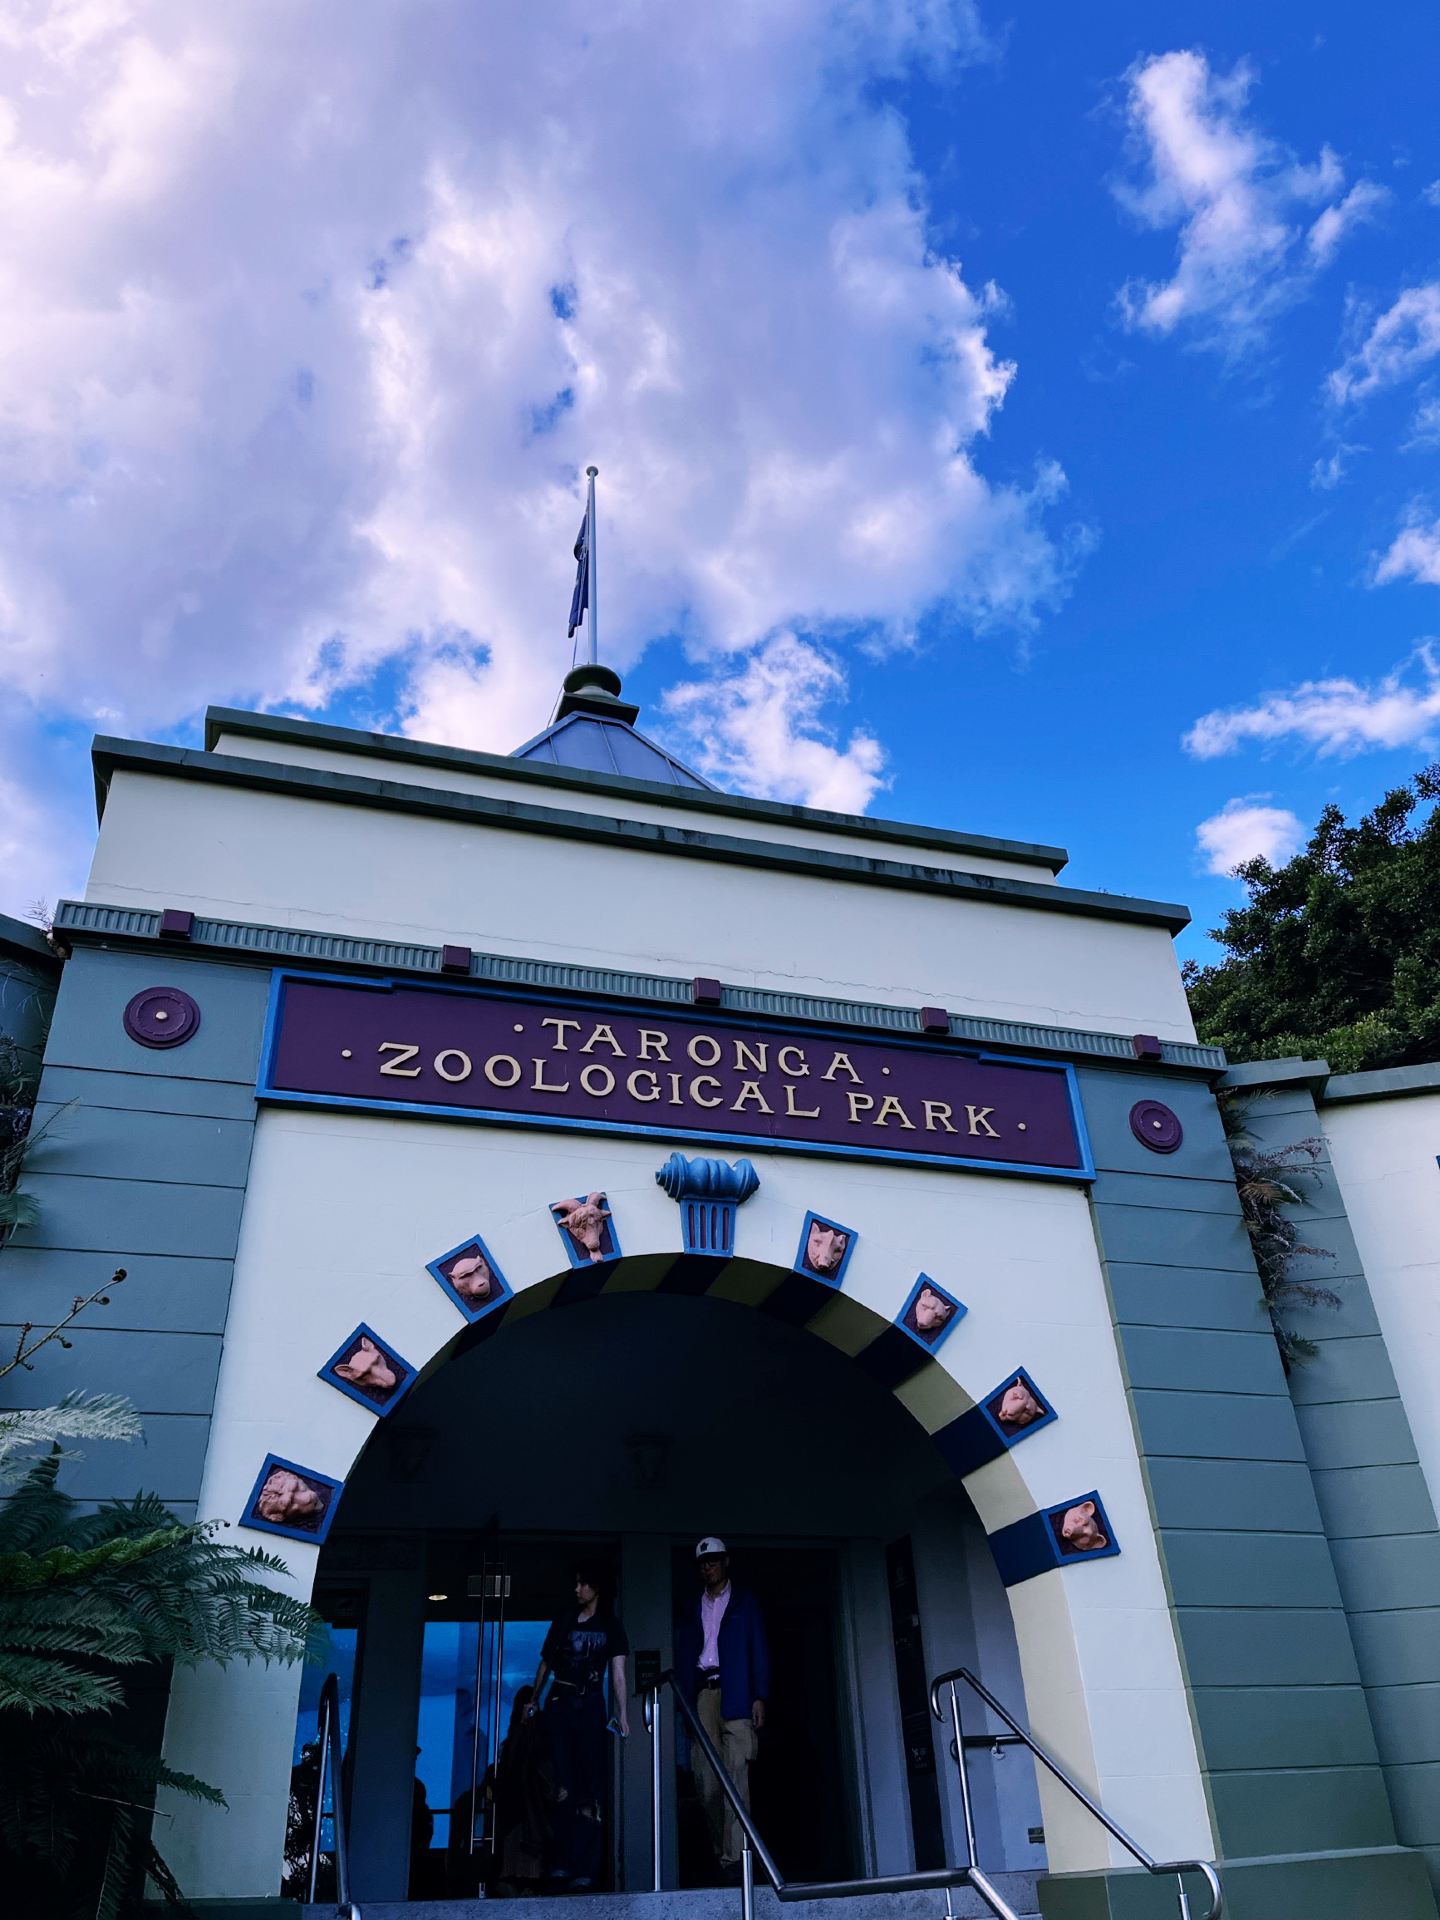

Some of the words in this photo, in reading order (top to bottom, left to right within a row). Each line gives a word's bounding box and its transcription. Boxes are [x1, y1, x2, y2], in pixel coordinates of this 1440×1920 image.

[377, 1041, 821, 1118] ZOOLOGICAL
[845, 1091, 1001, 1138] PARK
[541, 1017, 864, 1084] TARONGA
